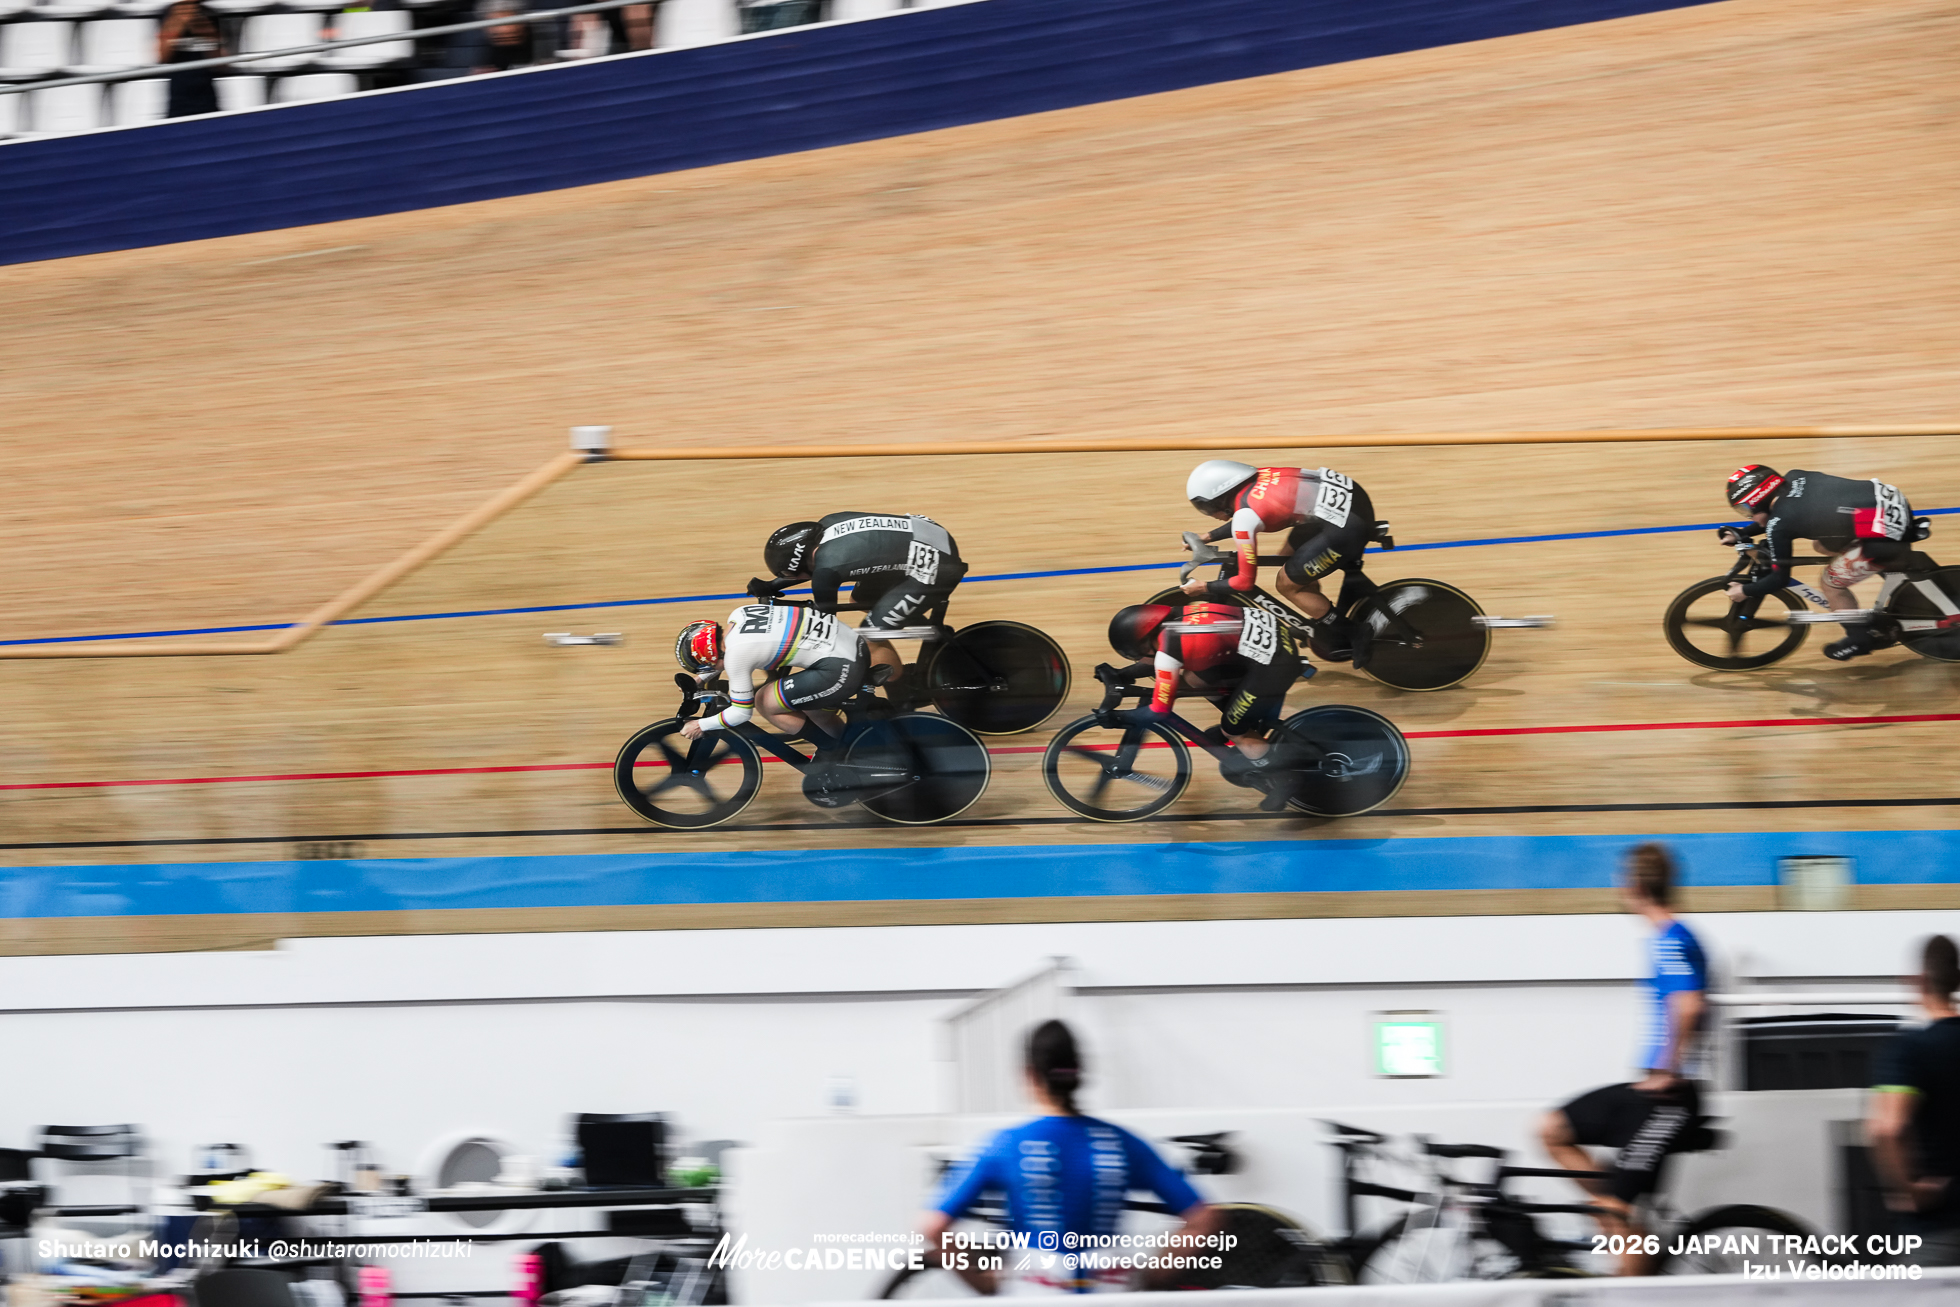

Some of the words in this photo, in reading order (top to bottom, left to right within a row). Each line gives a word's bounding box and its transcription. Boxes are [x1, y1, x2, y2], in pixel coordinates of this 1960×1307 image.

[1321, 486, 1348, 513] 132
[833, 520, 857, 537] NEW
[858, 517, 910, 531] ZEALAND
[787, 542, 806, 572] KASK
[1302, 547, 1343, 578] CHINA
[850, 566, 870, 577] NEW
[881, 594, 926, 627] NZL
[1253, 594, 1315, 639] KOGA
[706, 627, 714, 656] JAPAN
[806, 617, 832, 640] 141
[1246, 622, 1273, 650] 133
[838, 664, 851, 684] TEAM
[1226, 690, 1258, 726] CHINA
